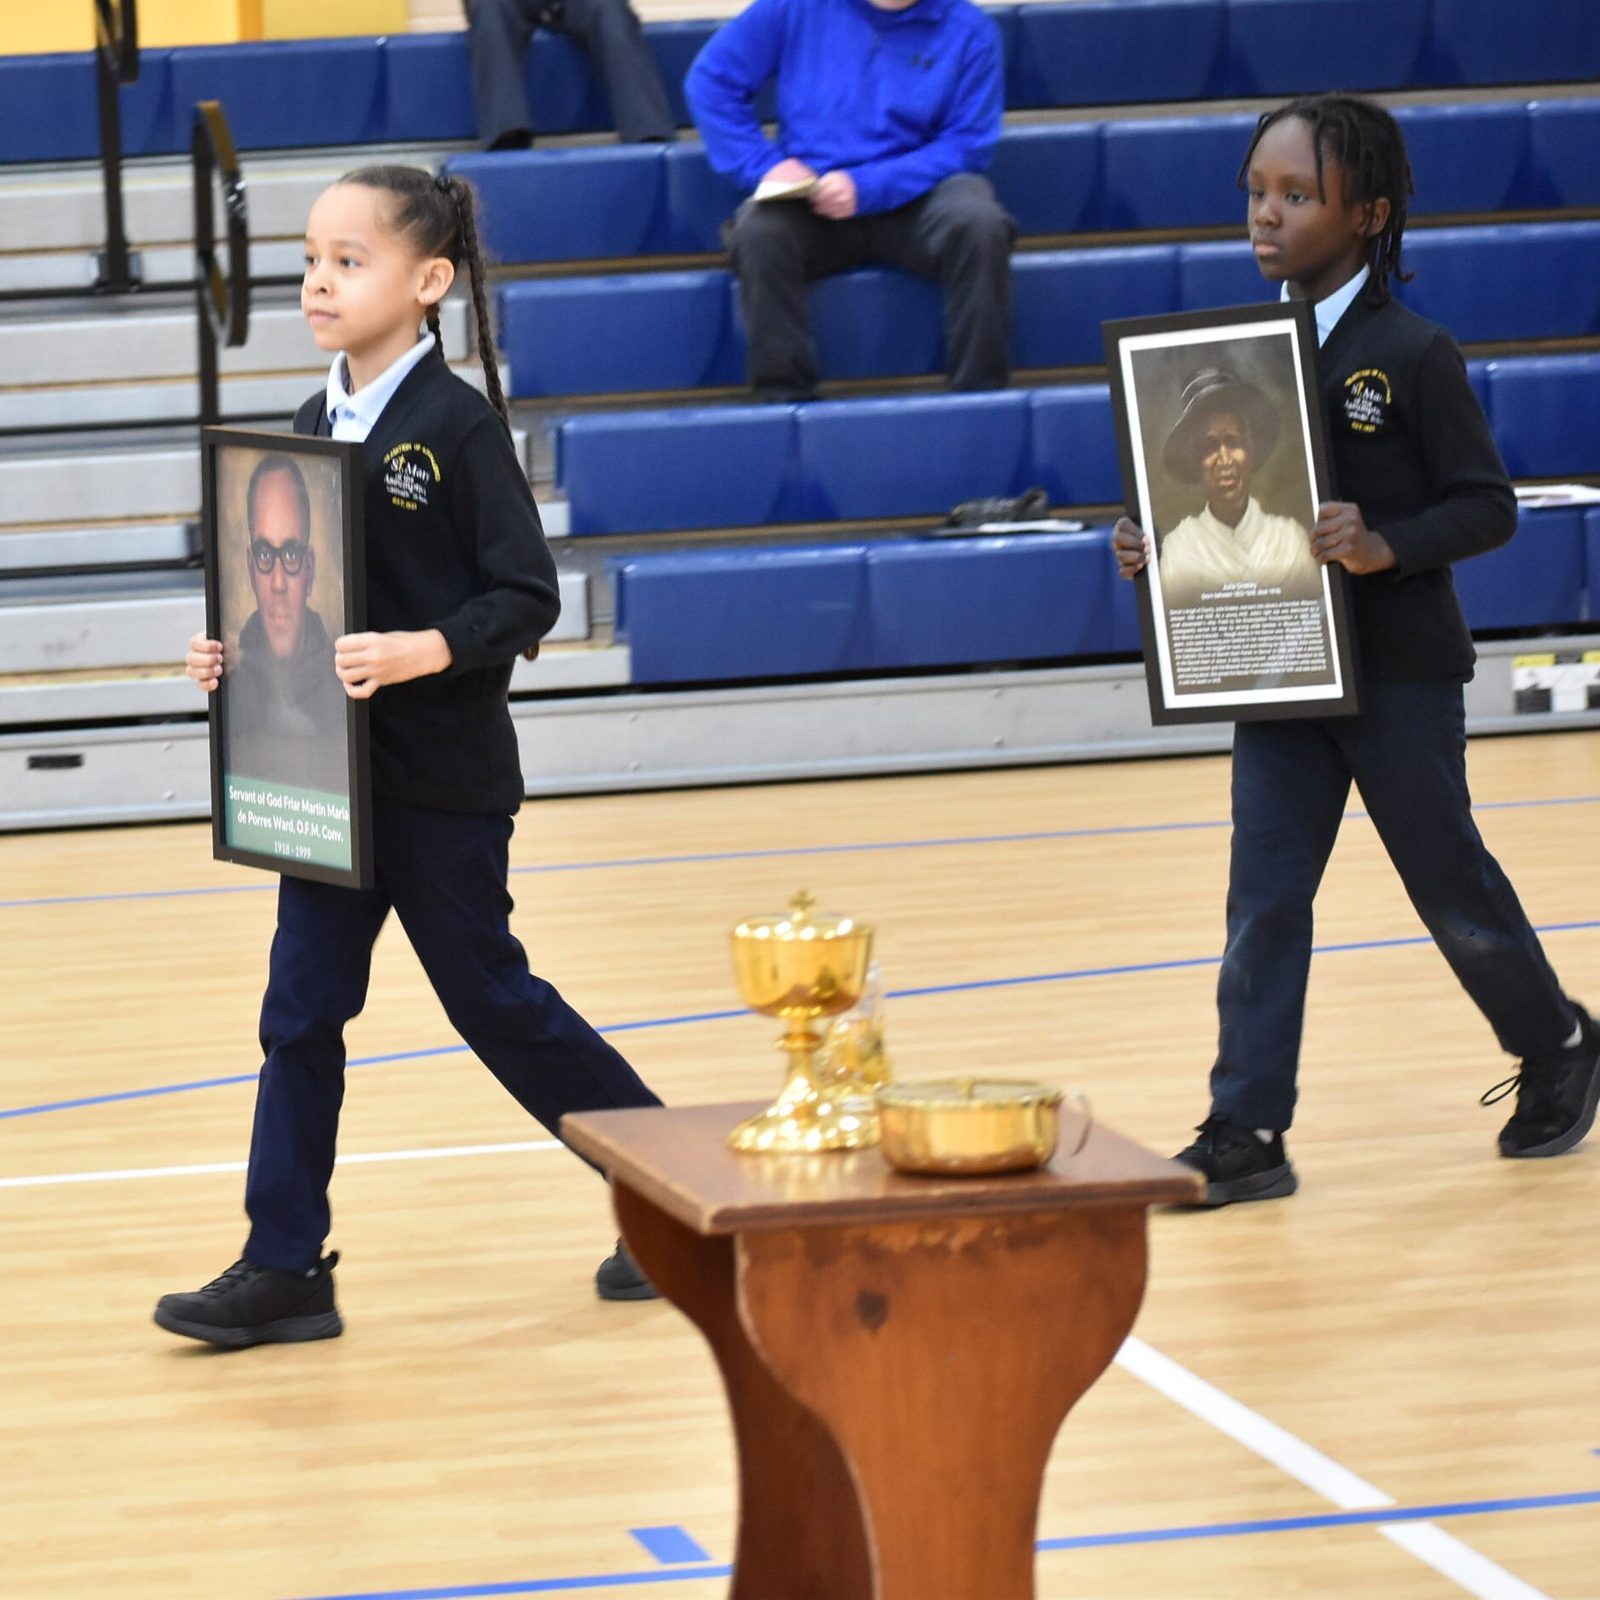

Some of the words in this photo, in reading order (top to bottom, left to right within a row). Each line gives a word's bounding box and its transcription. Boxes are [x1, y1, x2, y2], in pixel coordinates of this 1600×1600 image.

[229, 785, 257, 804] Servant
[257, 792, 266, 805] of
[266, 791, 283, 809] God
[283, 796, 300, 813] Friar
[301, 799, 326, 817] Martin
[327, 804, 349, 821] Maria
[237, 809, 247, 823] de
[248, 811, 272, 828] Porres
[273, 815, 296, 834] Ward,
[296, 820, 321, 839] O.F.M.
[321, 825, 344, 843] Conv.
[274, 841, 290, 856] 1918
[295, 844, 312, 860] 1999
